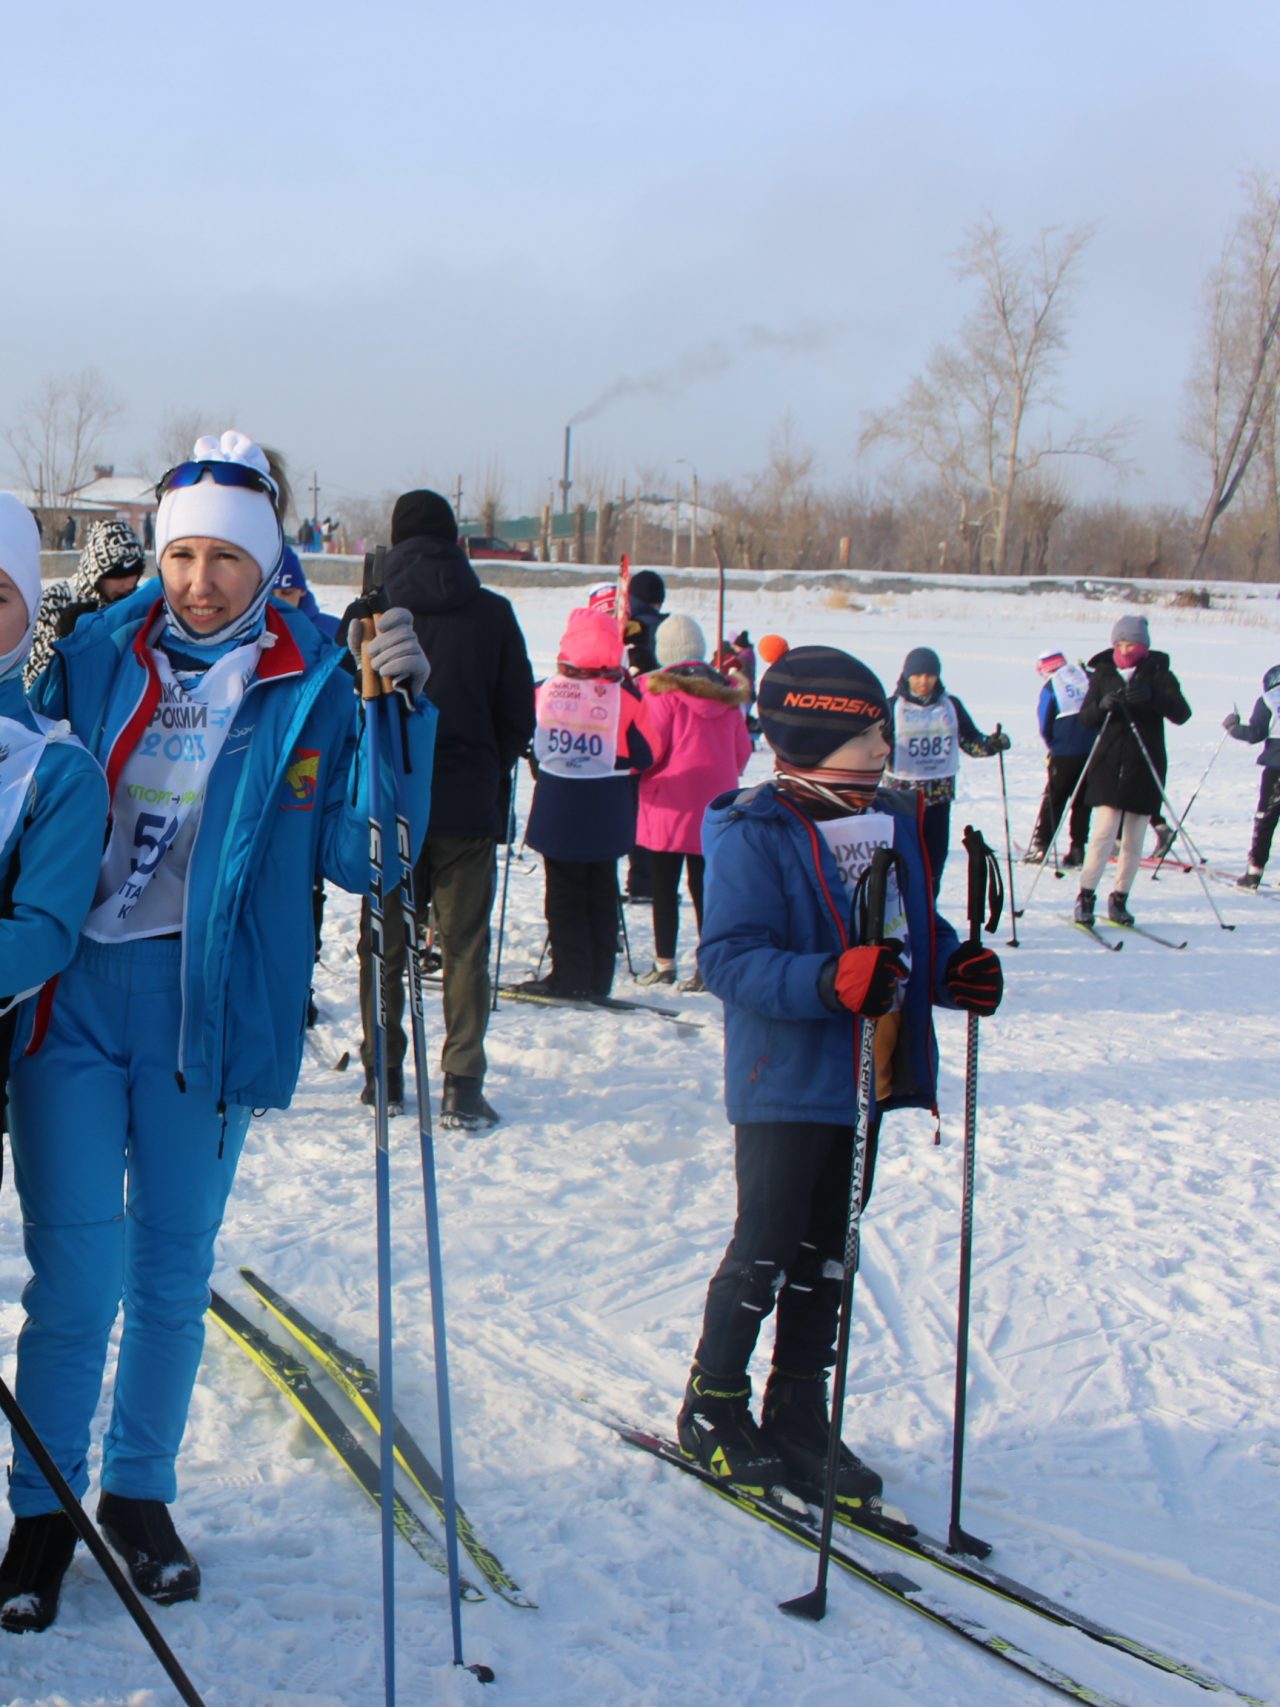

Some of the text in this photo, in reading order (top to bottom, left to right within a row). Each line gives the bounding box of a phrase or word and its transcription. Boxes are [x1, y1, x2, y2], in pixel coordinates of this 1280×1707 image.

[783, 691, 882, 719] NORDSKI
[548, 728, 603, 756] 5940
[908, 735, 953, 758] 5983
